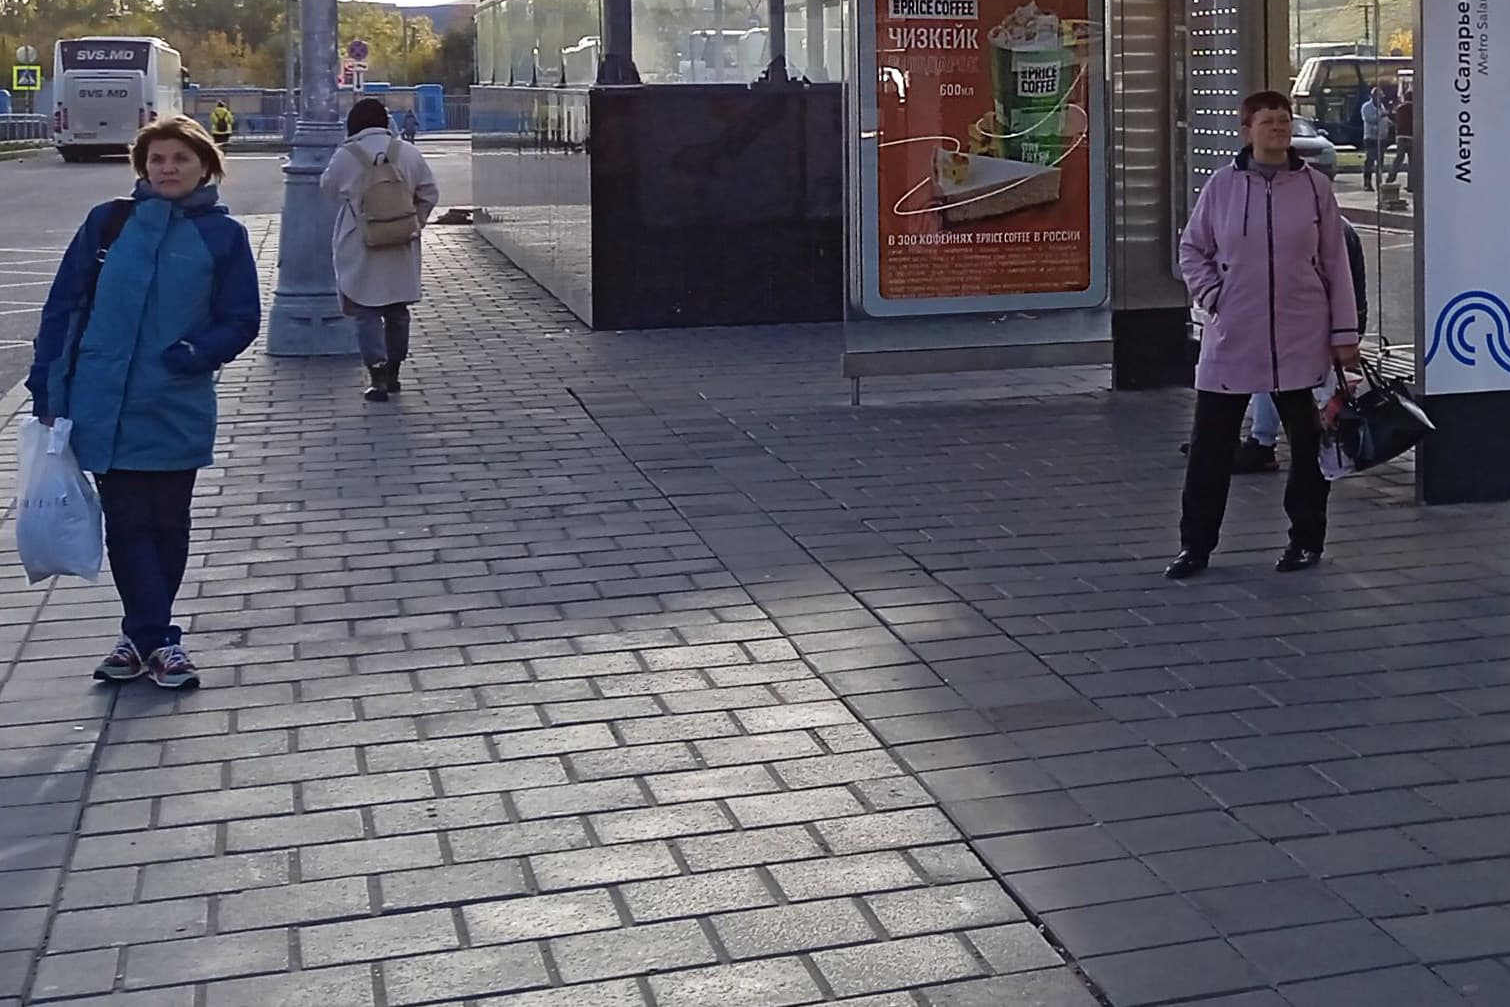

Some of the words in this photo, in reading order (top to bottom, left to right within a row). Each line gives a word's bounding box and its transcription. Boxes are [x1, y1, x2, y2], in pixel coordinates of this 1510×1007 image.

[900, 0, 933, 15] PRICE
[934, 0, 974, 16] COFFEE
[887, 24, 980, 50] ЧИЗКЕЙК
[76, 49, 134, 61] SVS.MD
[1477, 33, 1489, 76] Metro
[79, 89, 128, 99] SVS.MD
[1021, 79, 1057, 93] COFFEE
[1455, 109, 1475, 184] Метро
